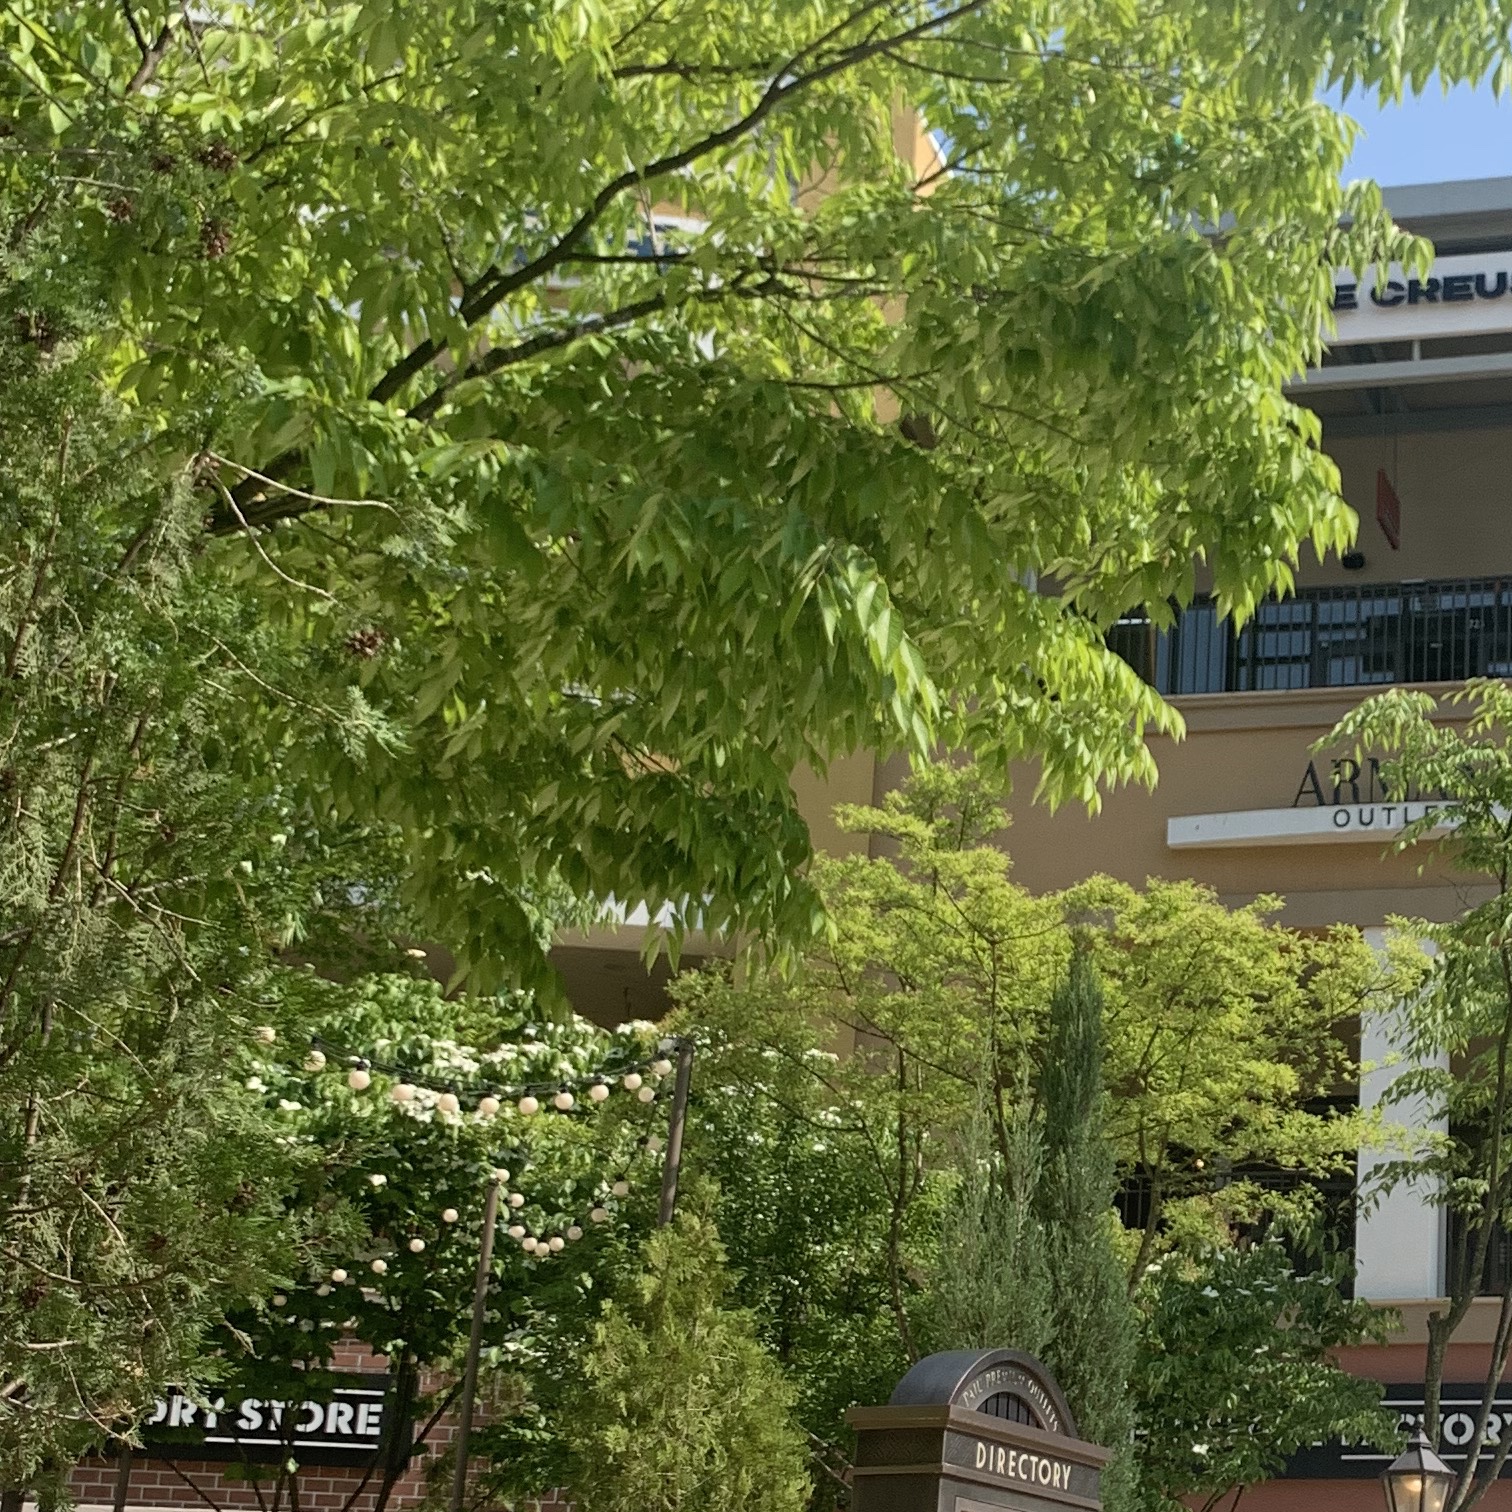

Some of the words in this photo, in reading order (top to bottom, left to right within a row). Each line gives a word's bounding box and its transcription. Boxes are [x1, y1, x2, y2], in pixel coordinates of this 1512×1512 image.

[1334, 284, 1358, 310] E
[237, 1397, 384, 1436] STORE
[976, 1441, 1072, 1490] DIRECTORY
